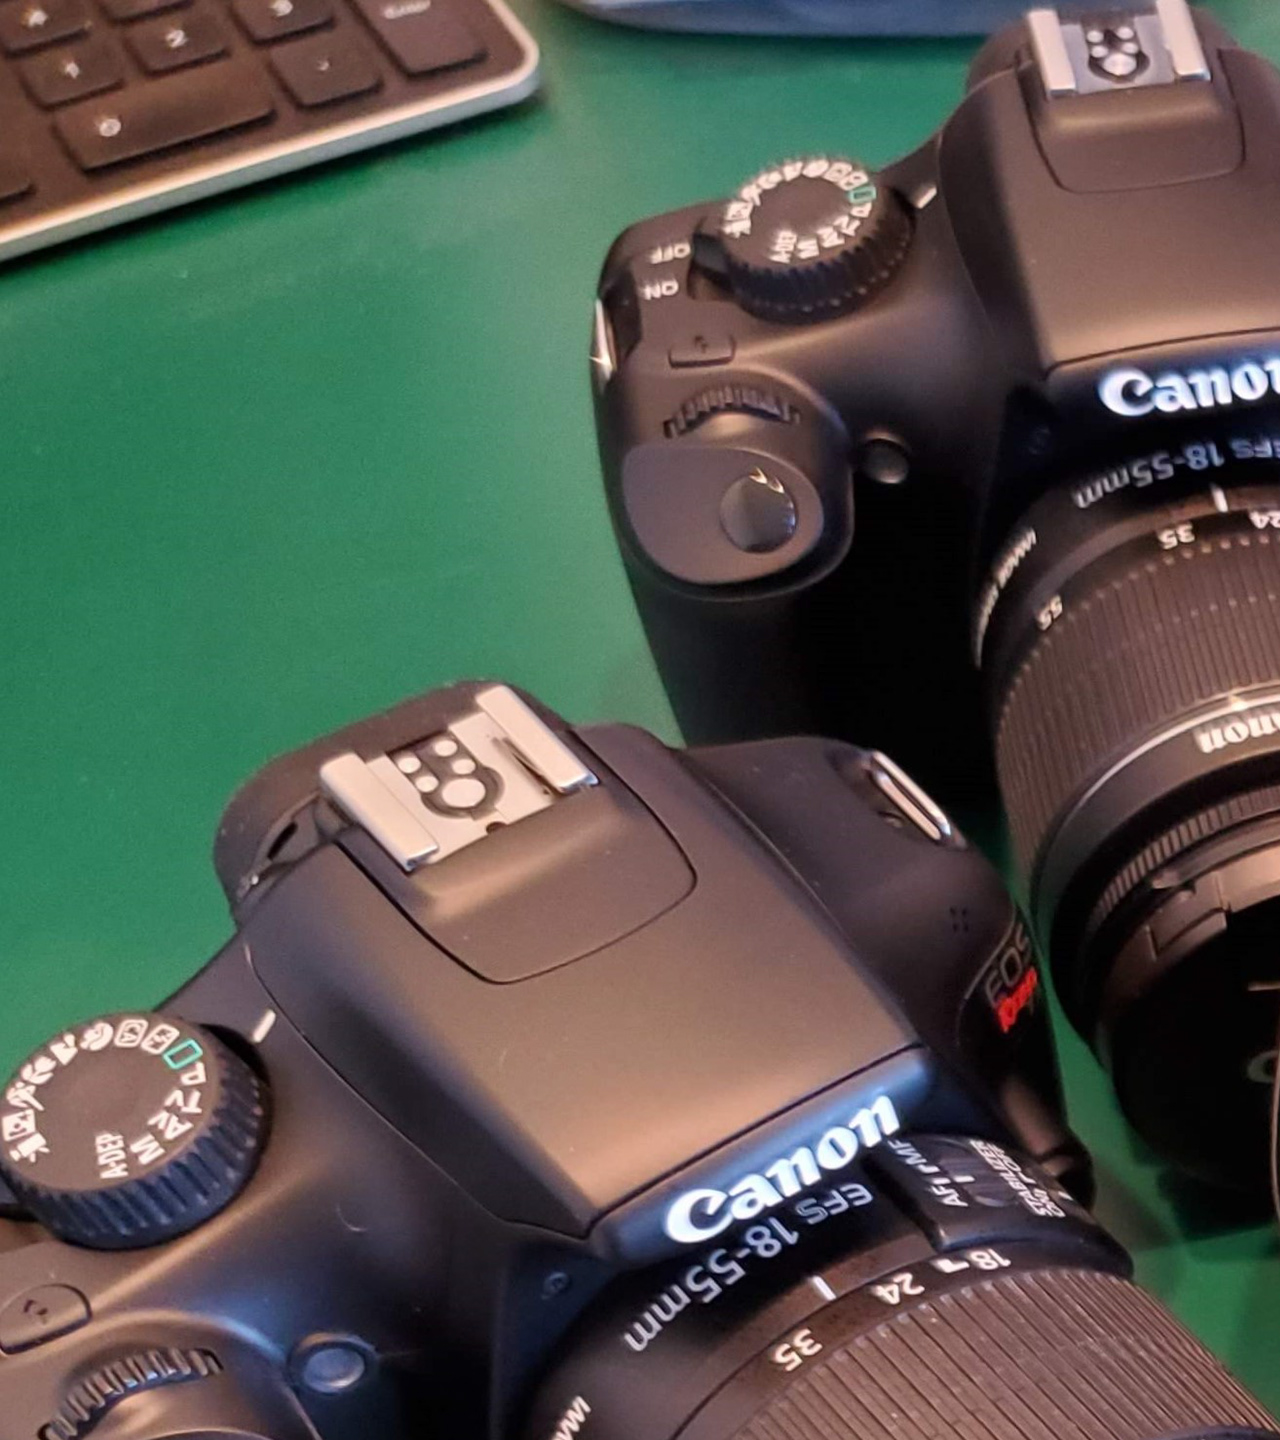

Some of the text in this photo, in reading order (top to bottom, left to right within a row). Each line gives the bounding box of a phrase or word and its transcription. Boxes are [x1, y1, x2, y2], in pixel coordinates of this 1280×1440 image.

[643, 280, 678, 300] ON
[1073, 439, 1226, 509] 18-55mm
[1158, 523, 1196, 549] 35
[180, 1062, 206, 1086] P
[95, 1130, 129, 1179] A-DEP
[130, 1134, 165, 1165] M
[664, 1095, 900, 1244] Canon
[969, 1139, 1054, 1218] STABILIZER
[931, 1185, 969, 1207] AF
[623, 1182, 874, 1352] EFS 18-55mm
[969, 1248, 1012, 1270] 18
[871, 1272, 926, 1306] 24
[772, 1328, 823, 1373] 35
